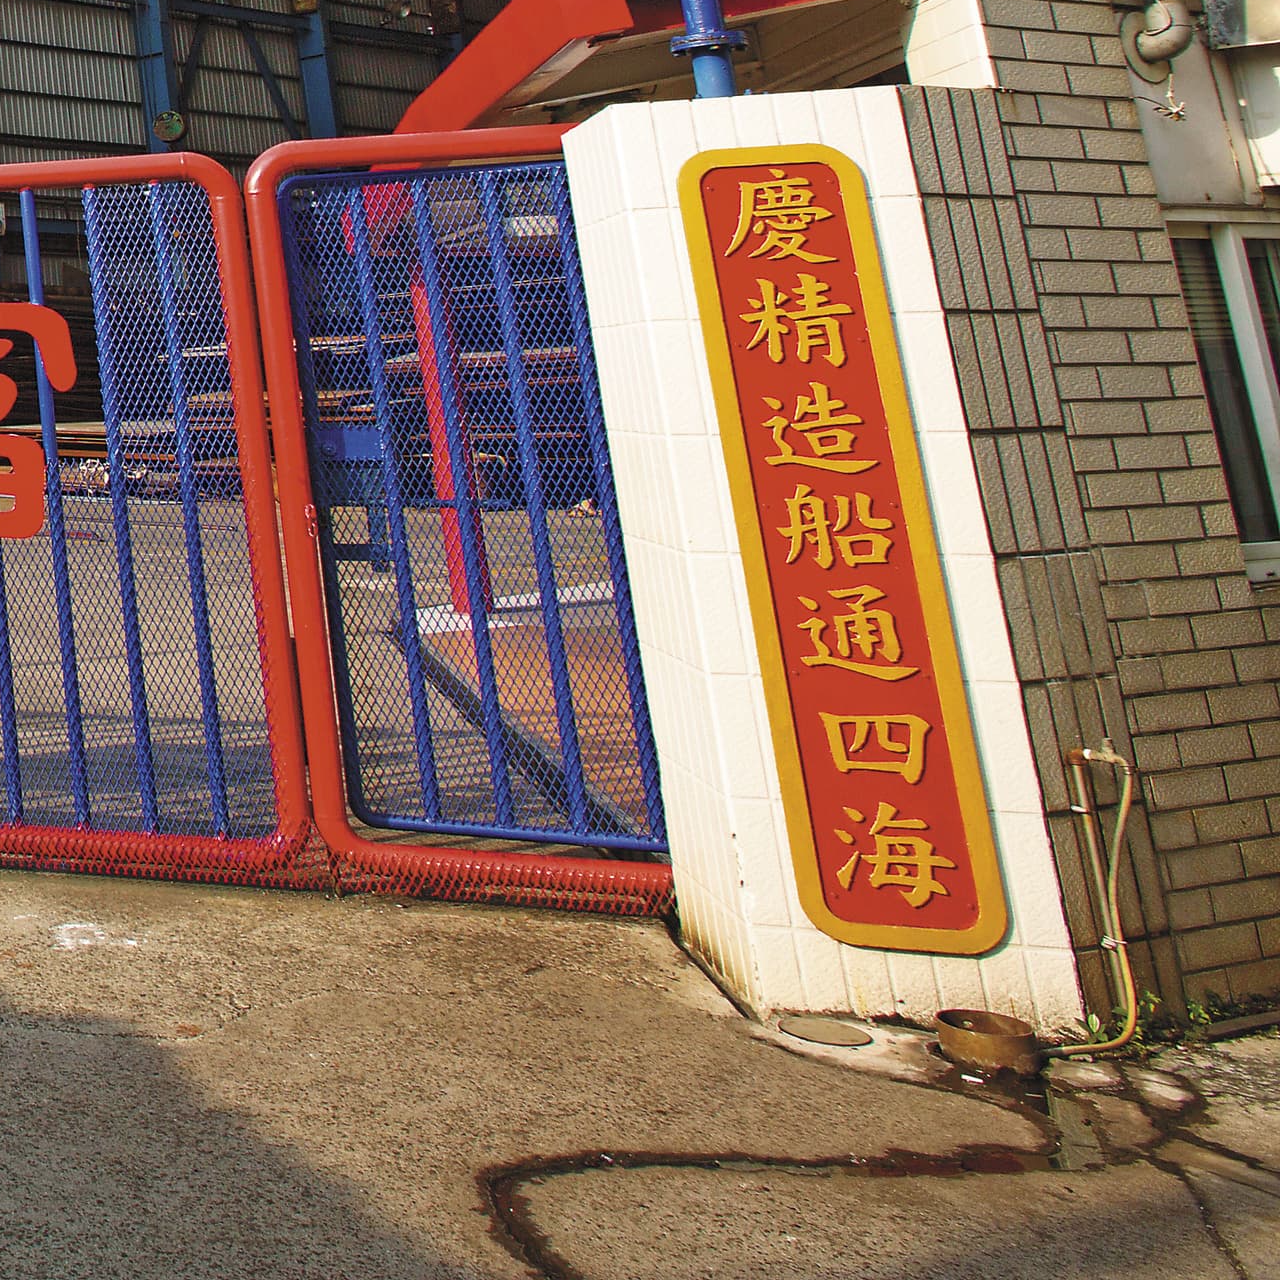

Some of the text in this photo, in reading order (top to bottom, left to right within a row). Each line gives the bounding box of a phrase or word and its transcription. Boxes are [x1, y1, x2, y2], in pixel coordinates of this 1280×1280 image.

[723, 169, 957, 909] 慶精造船通四海
